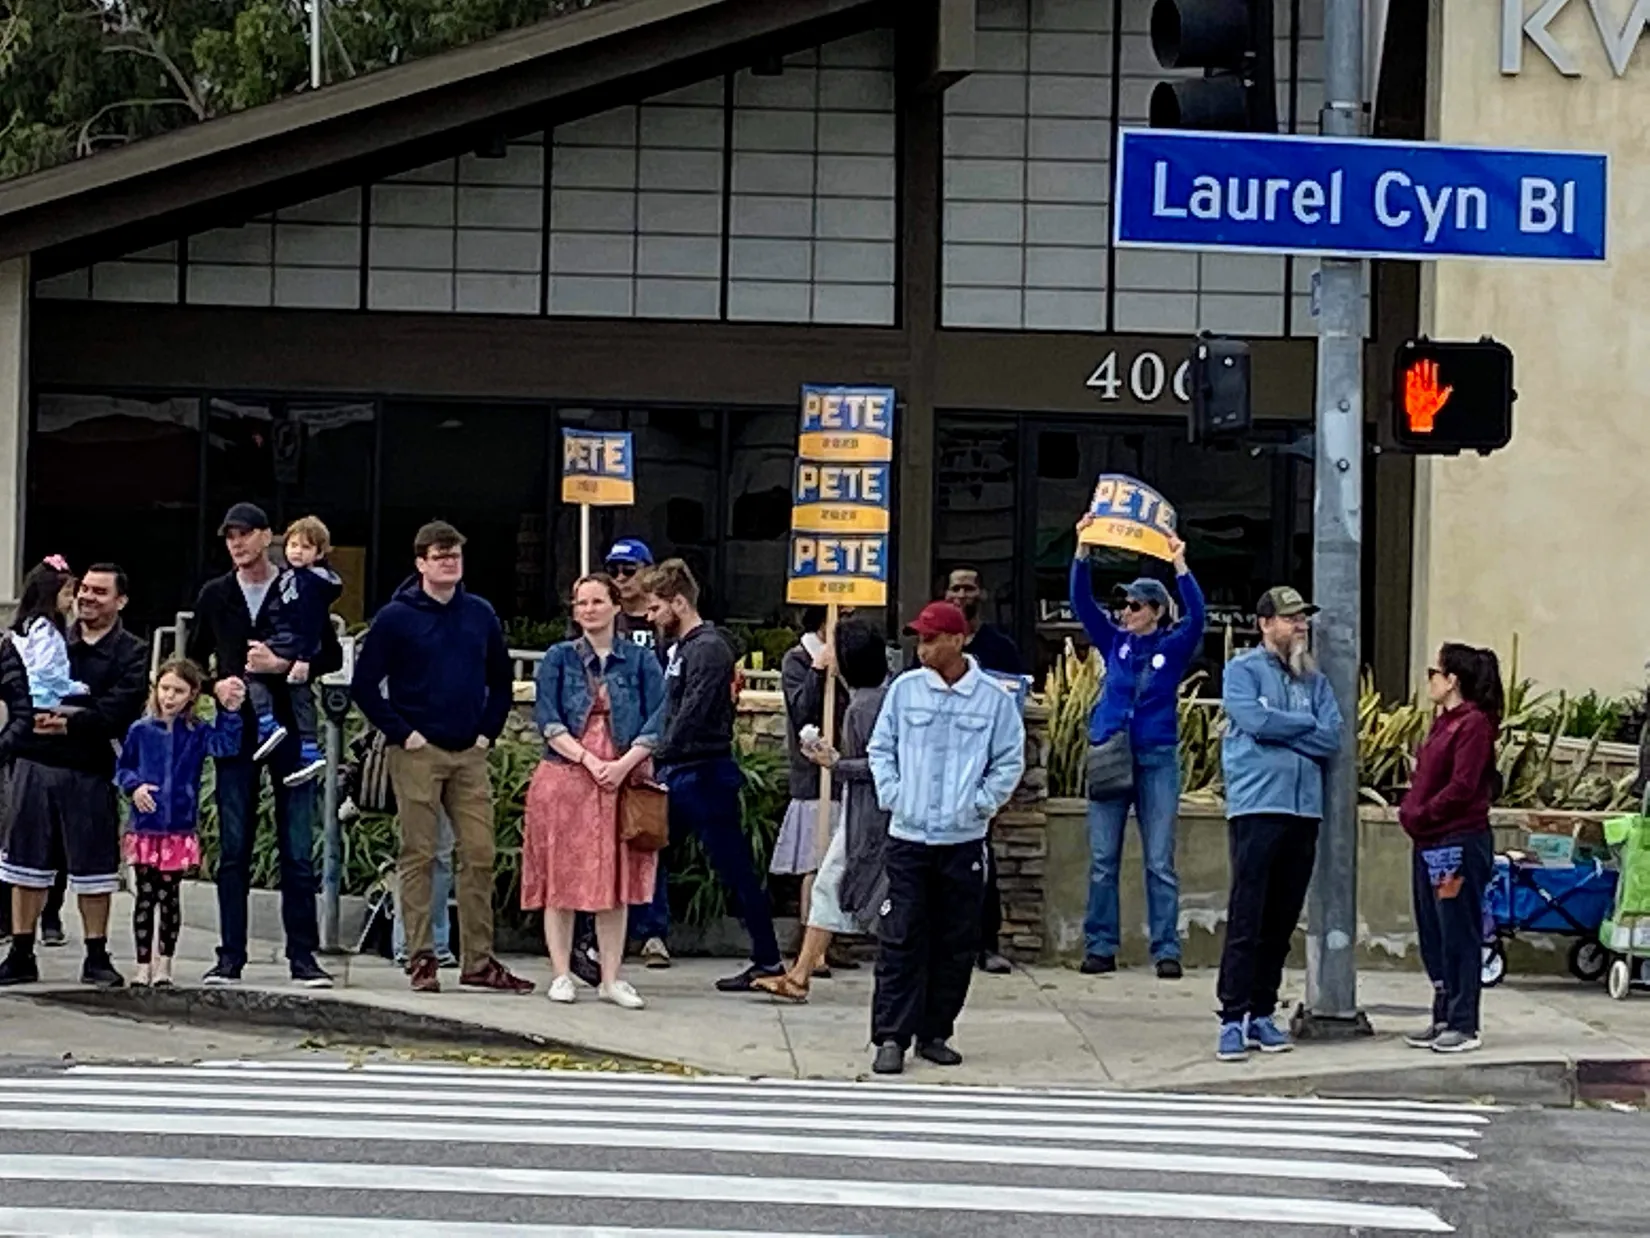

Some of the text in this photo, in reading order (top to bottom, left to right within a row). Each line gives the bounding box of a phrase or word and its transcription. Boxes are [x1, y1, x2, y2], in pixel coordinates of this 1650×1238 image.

[1152, 161, 1574, 242] Laurel Cyn Bl
[803, 392, 887, 430] PETE
[563, 436, 626, 474] PETE
[798, 464, 883, 502] PETE
[1091, 479, 1177, 534] PETE
[793, 537, 882, 577] PETE
